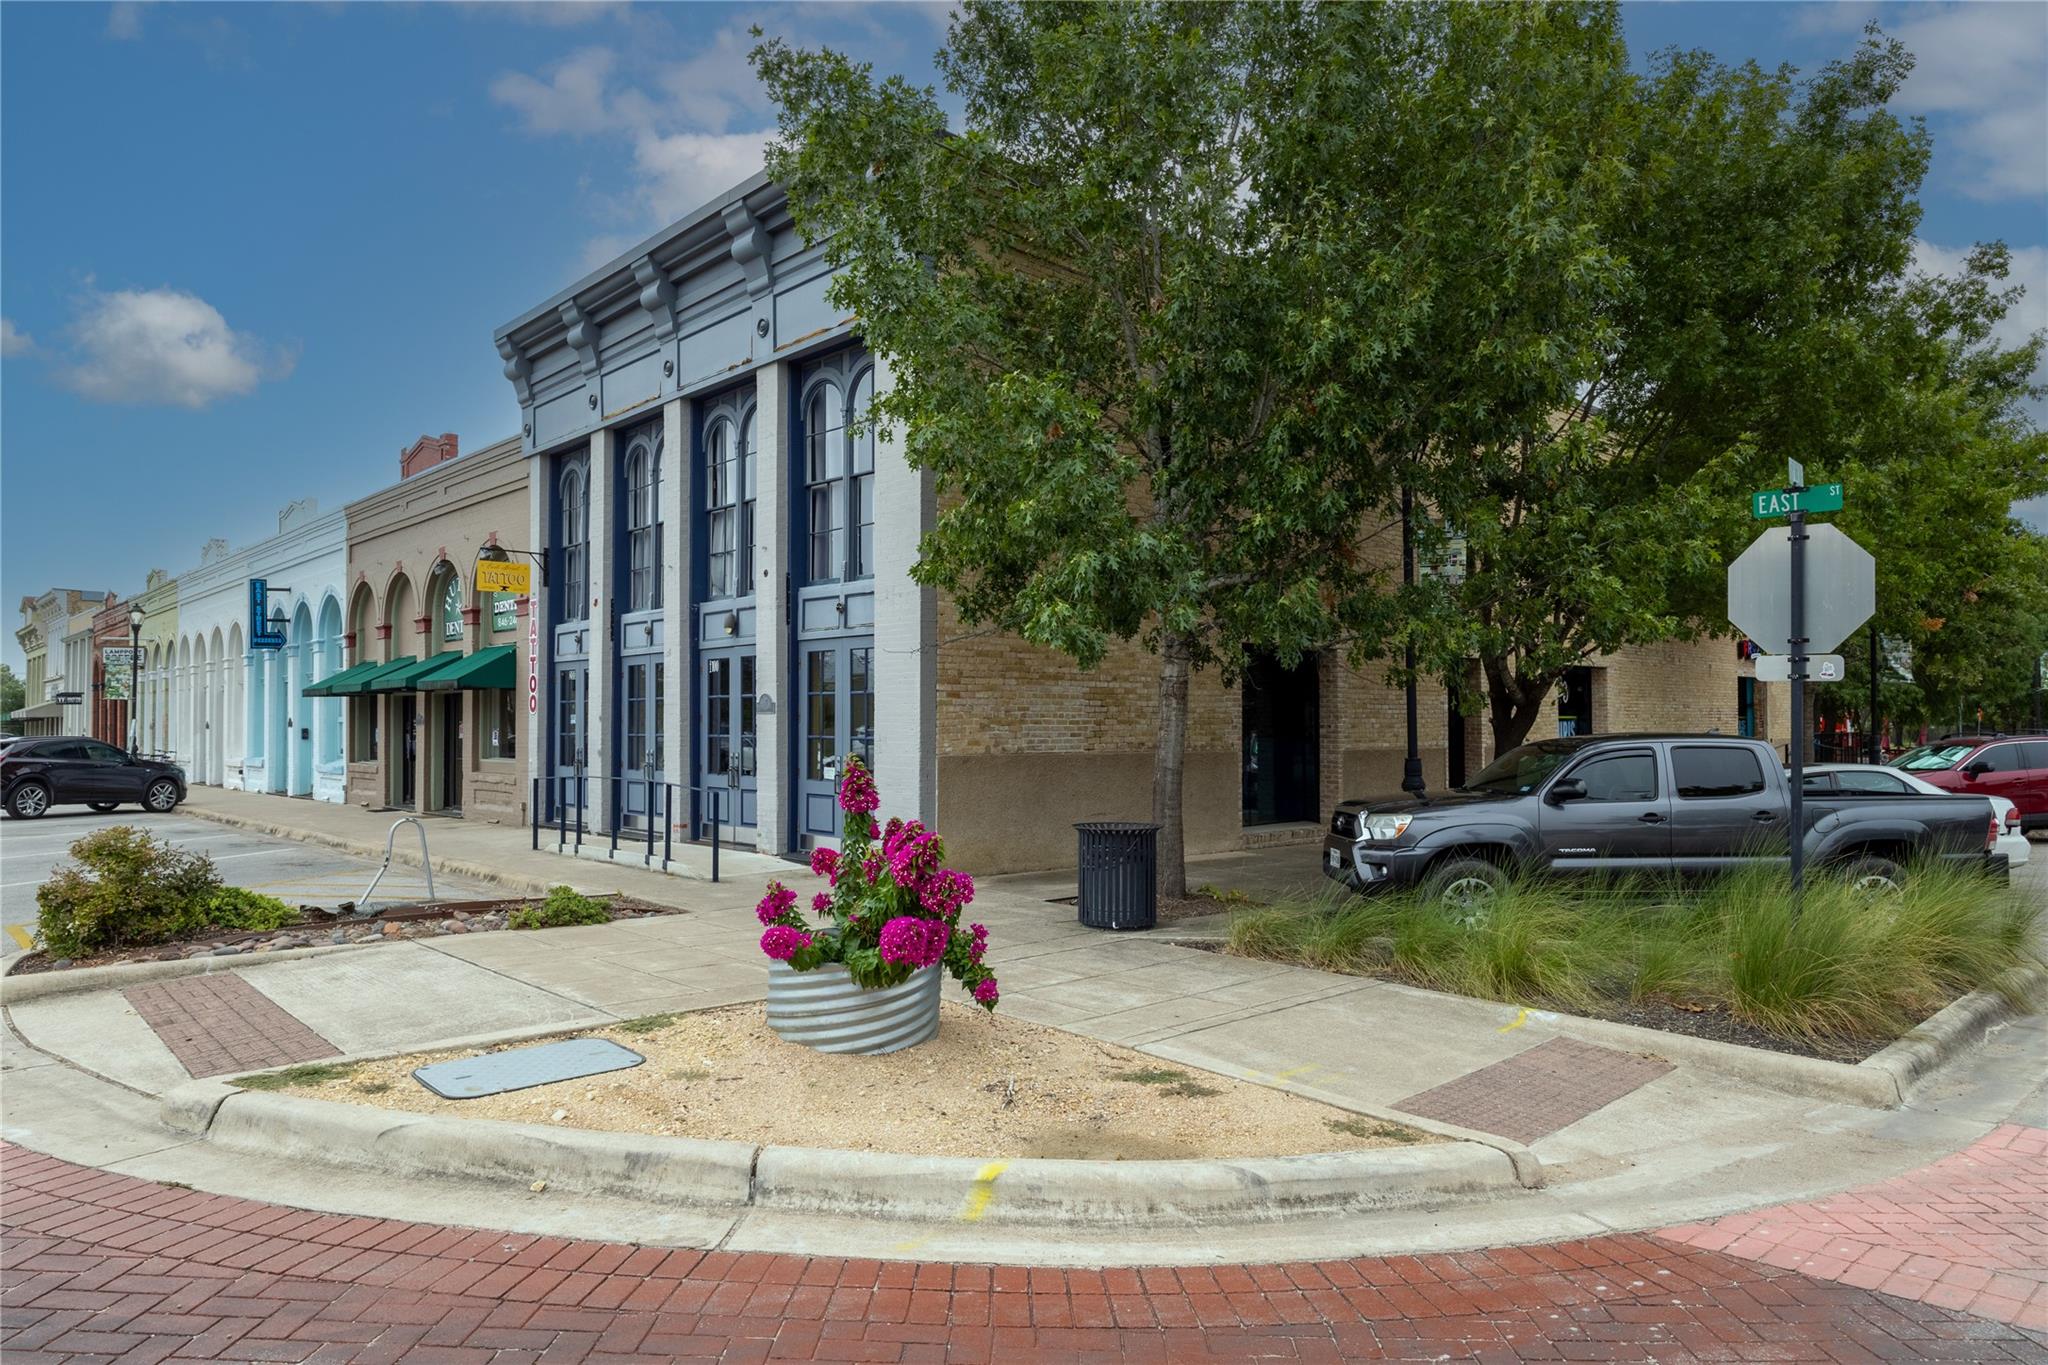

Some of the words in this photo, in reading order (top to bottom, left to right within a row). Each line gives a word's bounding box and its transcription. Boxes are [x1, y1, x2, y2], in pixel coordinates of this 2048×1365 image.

[1758, 492, 1799, 514] EAST
[1829, 485, 1841, 496] ST
[482, 571, 525, 585] TATTOO
[529, 600, 537, 713] TATTOO
